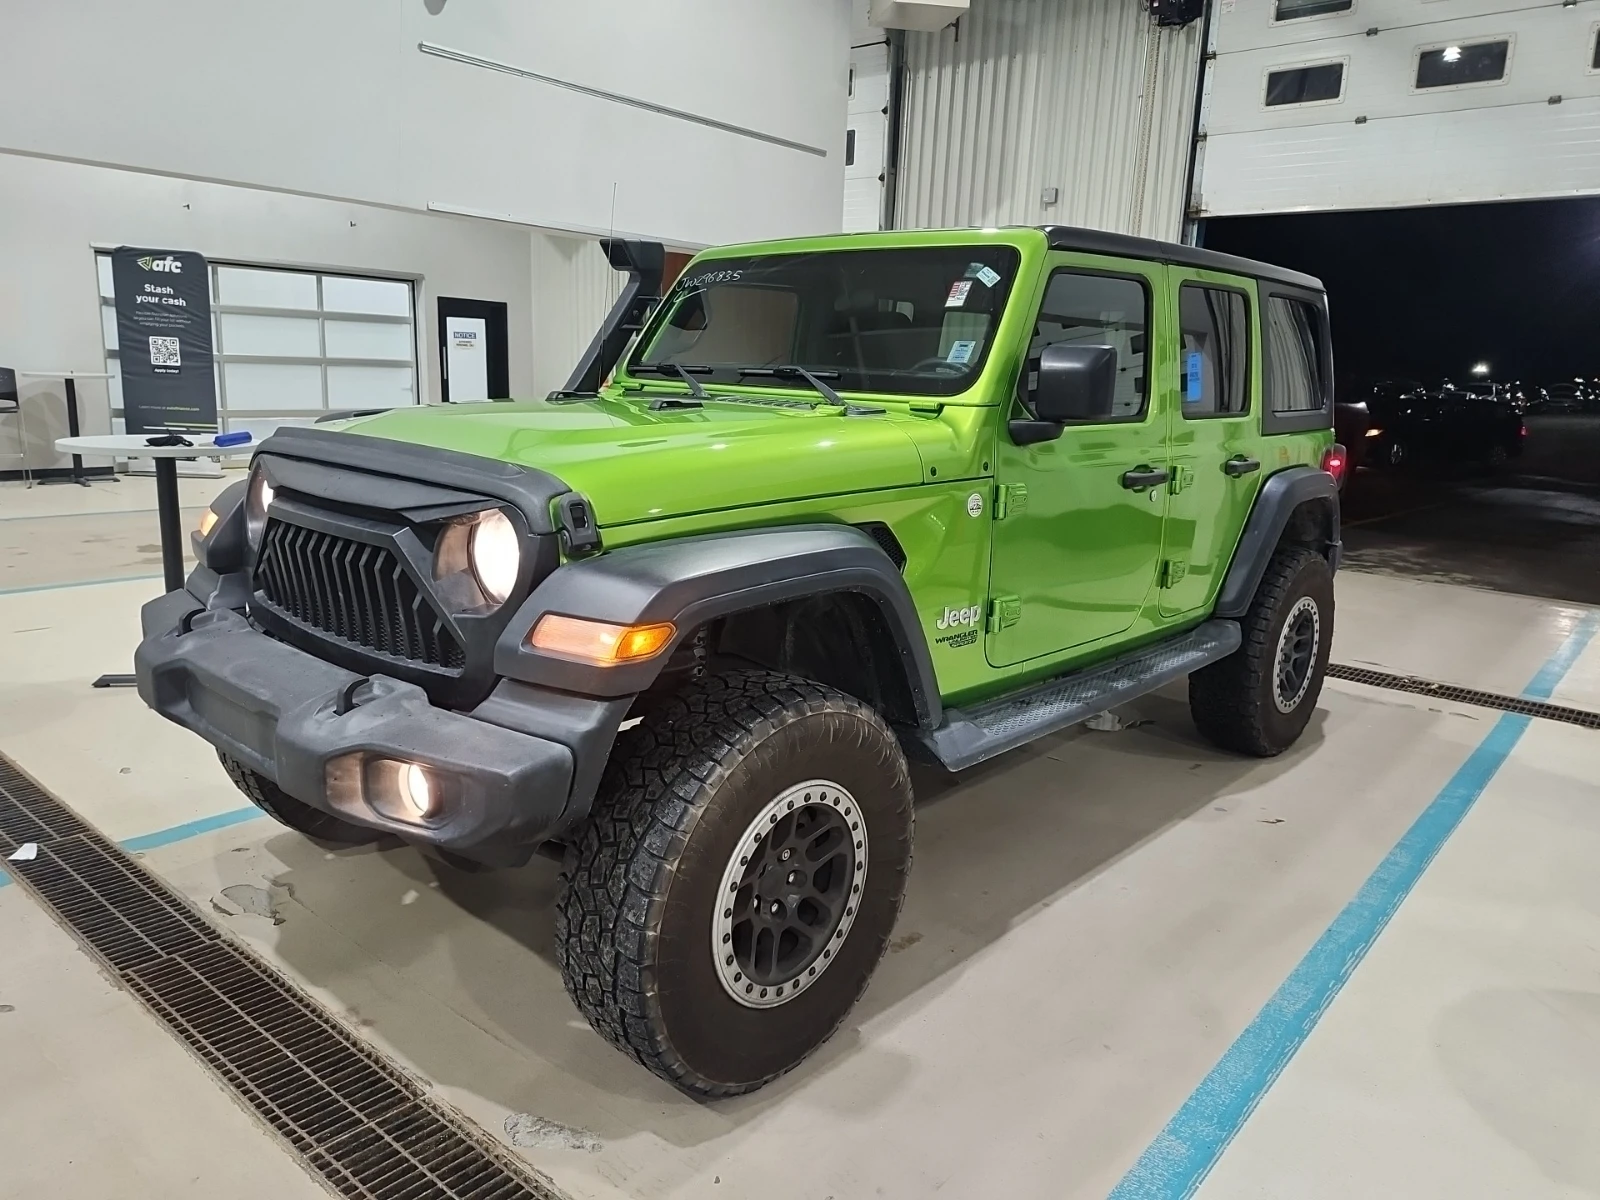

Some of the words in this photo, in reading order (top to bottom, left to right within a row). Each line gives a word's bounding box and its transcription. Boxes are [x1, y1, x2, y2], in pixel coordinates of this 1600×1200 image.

[152, 256, 182, 273] afc
[144, 284, 173, 294] Stash
[136, 295, 159, 303] your
[162, 297, 186, 306] cash
[936, 605, 981, 630] Jeep
[935, 629, 978, 644] WRANGLER
